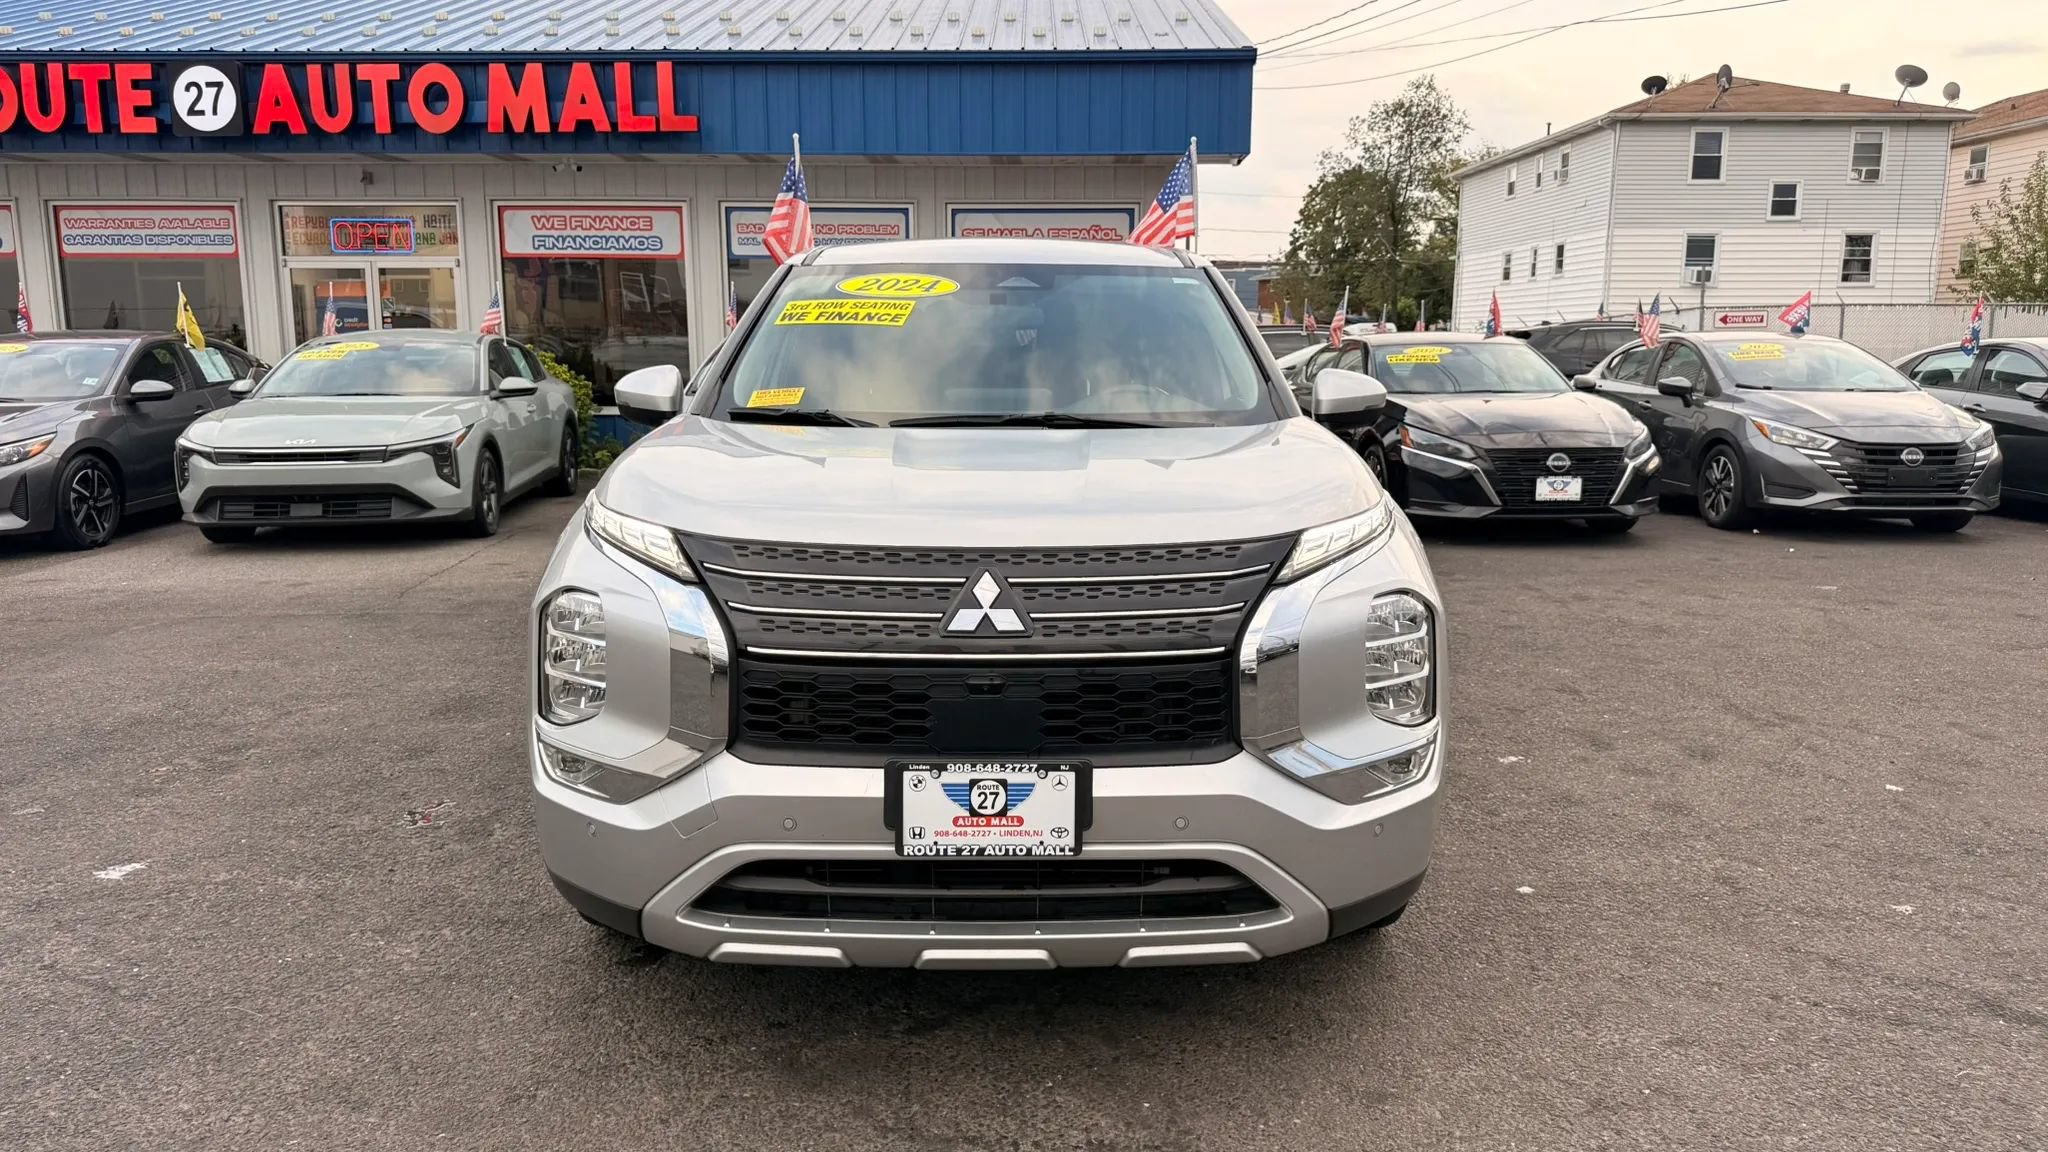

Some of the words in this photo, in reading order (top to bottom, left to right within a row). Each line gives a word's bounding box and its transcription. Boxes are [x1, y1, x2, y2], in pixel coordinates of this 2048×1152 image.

[183, 81, 224, 117] 27
[252, 62, 465, 135] AUTO
[487, 61, 698, 134] MALL
[64, 217, 154, 229] WARRANTIES
[158, 217, 230, 229] AVAILABLE
[531, 215, 566, 230] WE
[571, 216, 653, 231] FINANCE
[737, 223, 766, 234] BAD
[815, 224, 835, 235] NO
[837, 224, 900, 235] PROBLEM
[333, 222, 412, 250] OPEN
[962, 227, 983, 238] SE
[987, 228, 1044, 240] HABLA
[1048, 224, 1124, 241] ESPAÑOL
[63, 234, 143, 246] GARANTIAS
[145, 234, 234, 246] DISPONIBLES
[533, 235, 663, 250] FINANCIAMOS
[738, 236, 761, 246] MAL
[855, 278, 943, 292] 2024
[786, 303, 811, 311] 3rd
[812, 302, 848, 310] ROW
[850, 301, 911, 311] SEATING
[780, 311, 814, 322] WE
[814, 311, 907, 323] FINANCE
[1726, 316, 1743, 324] ONE
[1744, 315, 1762, 323] WAY
[946, 763, 1038, 773] 908-648-2727
[977, 792, 1000, 810] 27
[957, 817, 987, 826] AUTO
[990, 817, 1020, 826] MALL
[903, 845, 957, 856] ROUTE
[961, 845, 979, 856] 27
[984, 845, 1027, 856] AUTO
[1031, 845, 1074, 856] MALL
